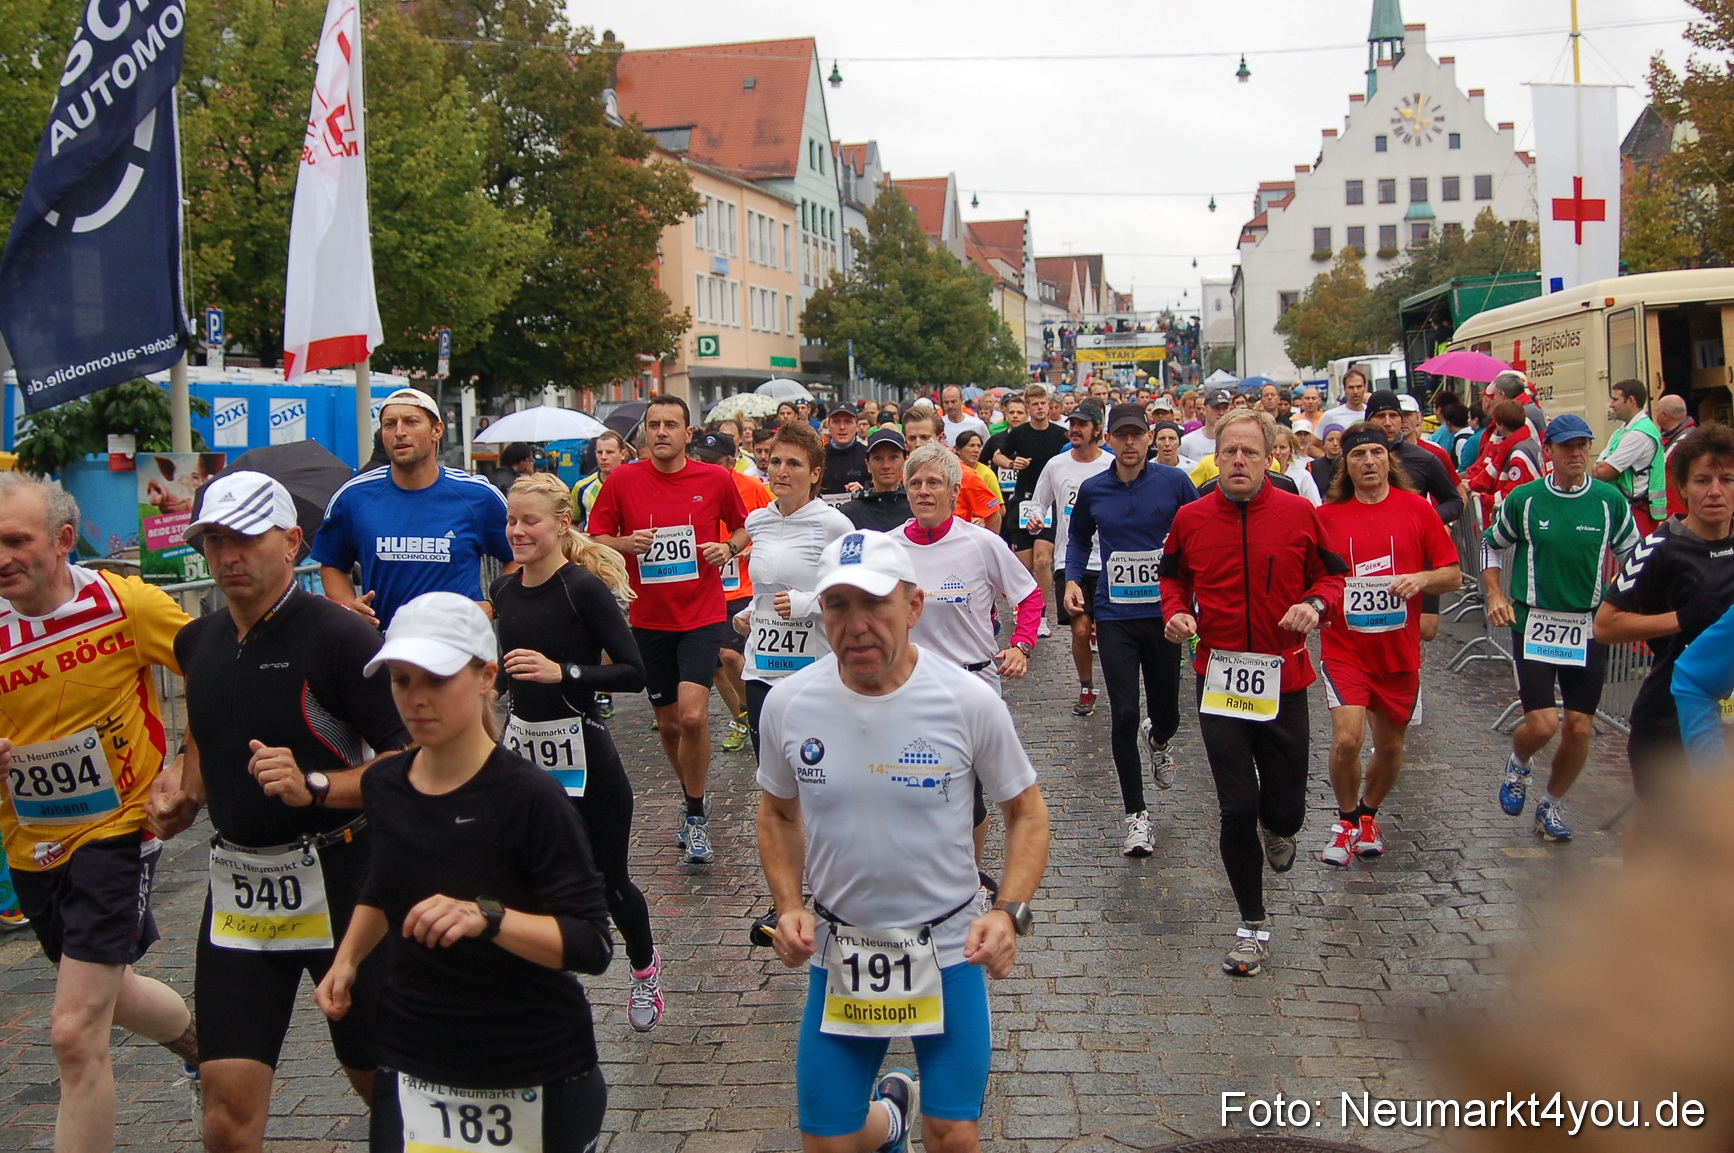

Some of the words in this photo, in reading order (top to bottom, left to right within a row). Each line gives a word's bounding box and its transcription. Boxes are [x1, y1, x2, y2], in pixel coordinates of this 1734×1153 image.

[51, 1, 186, 157] AUTOMO
[700, 337, 717, 355] D
[1530, 328, 1581, 358] Bayerisches
[1105, 351, 1137, 359] START
[1530, 359, 1554, 379] Rotes
[1069, 491, 1077, 506] 2
[655, 531, 684, 539] Neumarkt
[376, 536, 451, 554] HUBER
[391, 553, 448, 561] TECHNOLOGY
[1113, 563, 1160, 584] 2163
[1124, 588, 1153, 597] Karsten
[1350, 590, 1401, 612] 2330
[755, 617, 771, 626] PARTL
[771, 619, 803, 628] Neumarkt
[1364, 615, 1387, 626] Josef
[1529, 612, 1549, 621] PARTL
[1550, 616, 1579, 624] Neumarkt
[757, 627, 809, 654] 2247
[1531, 621, 1582, 646] 2570
[55, 638, 135, 673] BÖGL
[1536, 646, 1573, 658] Reinhard
[767, 658, 794, 669] Heike
[1233, 658, 1269, 667] Neumarkt
[1222, 666, 1266, 695] 186
[1226, 697, 1255, 712] Ralph
[524, 728, 567, 738] Neumarkt
[27, 744, 81, 762] Neumarkt
[509, 735, 575, 768] 3191
[9, 755, 101, 797] 2894
[797, 767, 827, 778] PARTL
[868, 763, 888, 774] 14.
[40, 802, 89, 816] Johann
[242, 861, 298, 874] Neumarkt
[231, 873, 303, 911] 540
[222, 914, 301, 939] Rüdiger
[836, 935, 860, 947] RTL
[860, 937, 915, 949] Neumarkt
[842, 952, 912, 993] 191
[843, 1003, 917, 1023] Christoph
[402, 1075, 446, 1096] PARTL
[449, 1086, 517, 1100] Neumarkt
[429, 1100, 514, 1147] 183
